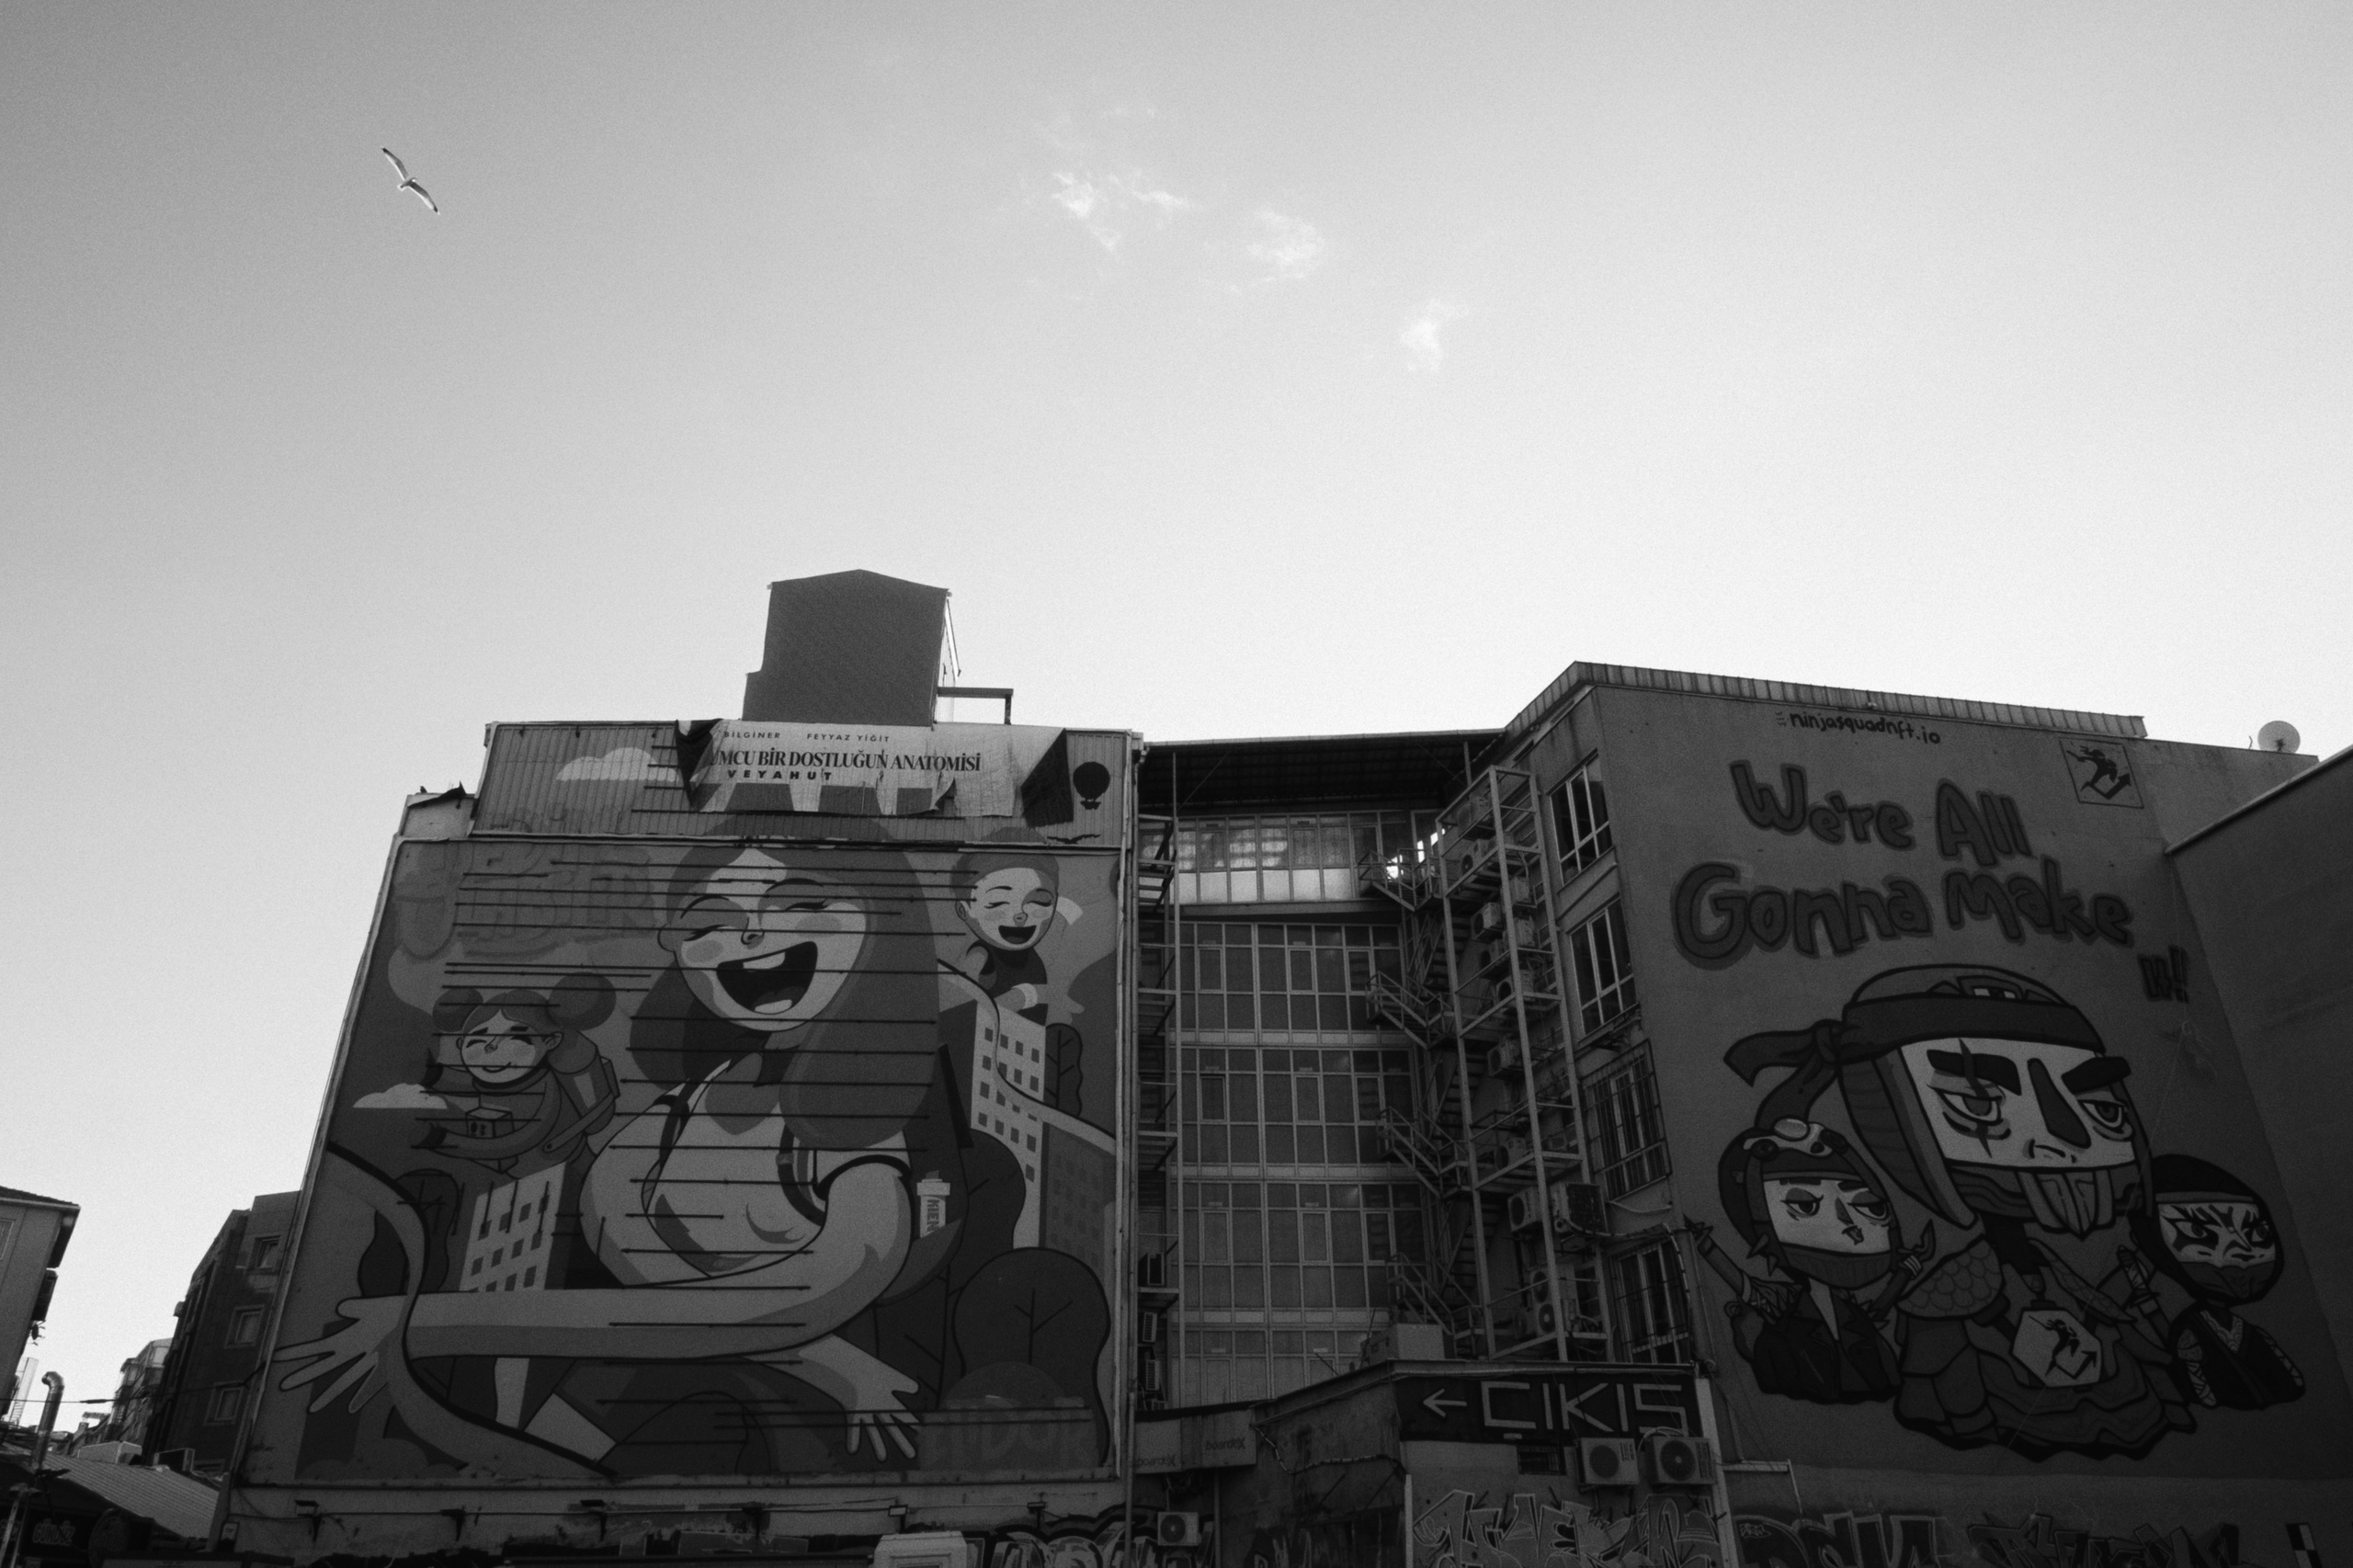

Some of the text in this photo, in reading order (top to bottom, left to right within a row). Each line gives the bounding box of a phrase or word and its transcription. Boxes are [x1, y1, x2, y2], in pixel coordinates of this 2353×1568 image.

[807, 733, 850, 742] FEYYAZ
[1790, 712, 1941, 744] ninjasquadnft.io
[757, 746, 786, 767] BİR
[789, 749, 890, 769] DOSTLUĞUN
[891, 752, 981, 772] ANATOMİSİ
[728, 769, 831, 780] VEYAHUT
[1731, 759, 2033, 865] We're All
[1671, 862, 1934, 970] Gonna
